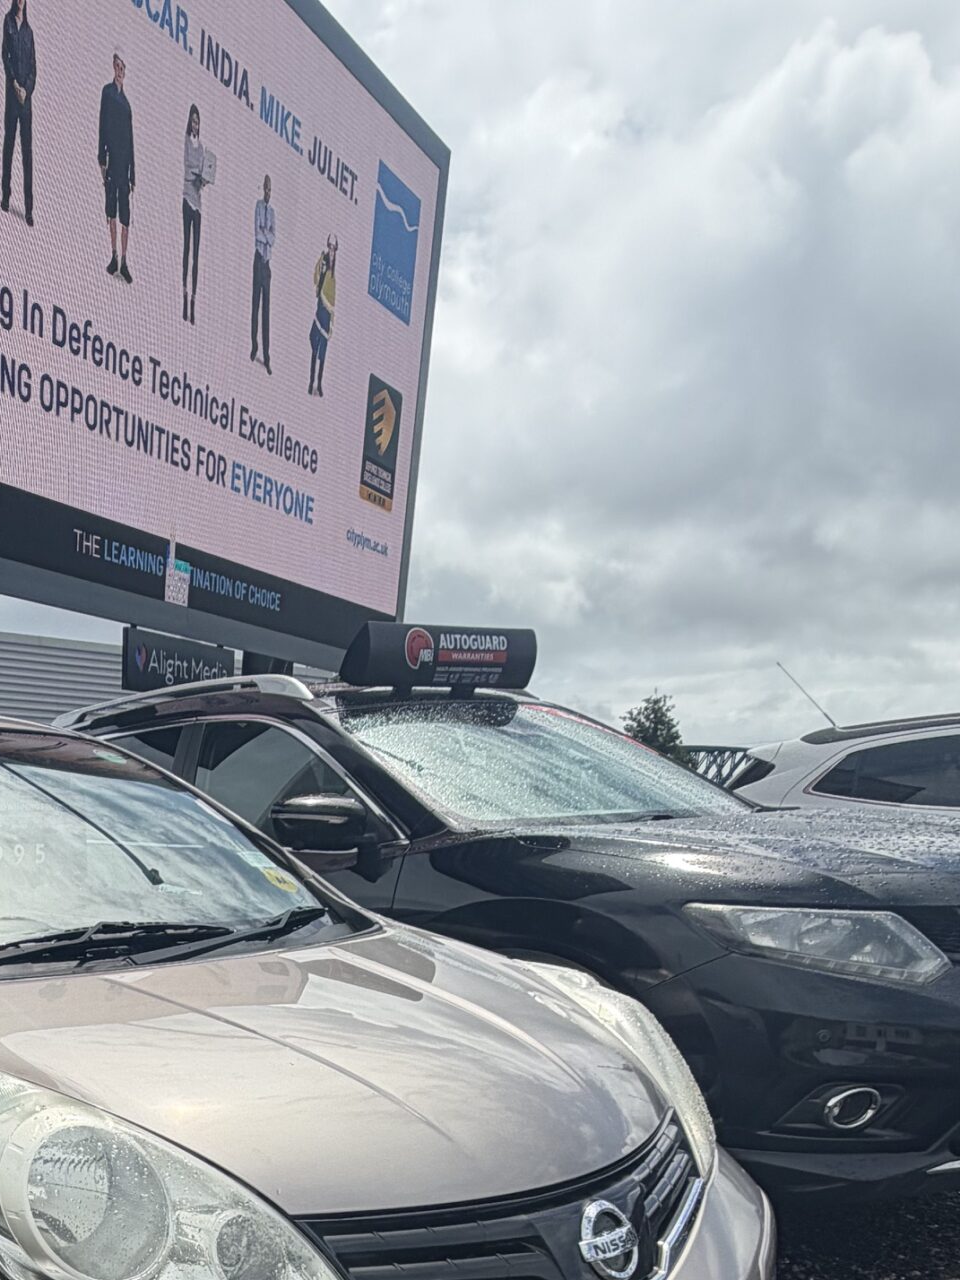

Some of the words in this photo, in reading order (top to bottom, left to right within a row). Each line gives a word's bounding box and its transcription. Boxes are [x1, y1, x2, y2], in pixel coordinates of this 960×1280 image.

[131, 0, 193, 55] CAR.
[199, 28, 254, 111] INDIA.
[259, 86, 304, 156] MIKE.
[308, 136, 358, 205] JULIET.
[370, 274, 410, 317] plymouth
[23, 288, 43, 338] In
[52, 304, 143, 387] Defence
[149, 356, 235, 432] Technical
[238, 405, 318, 474] Excellence
[40, 373, 190, 471] OPPORTUNITIES
[196, 444, 227, 488] FOR
[230, 460, 315, 525] EVERYONE
[346, 527, 389, 556] cityplym.ac.uk
[73, 528, 100, 559] THE
[104, 541, 164, 577] LEARNING
[234, 580, 248, 600] OF
[248, 585, 281, 611] CHOICE
[439, 633, 507, 650] AUTOGUARD
[451, 652, 494, 661] WARRANTIES
[148, 648, 188, 685] Alight
[191, 657, 228, 680] Media
